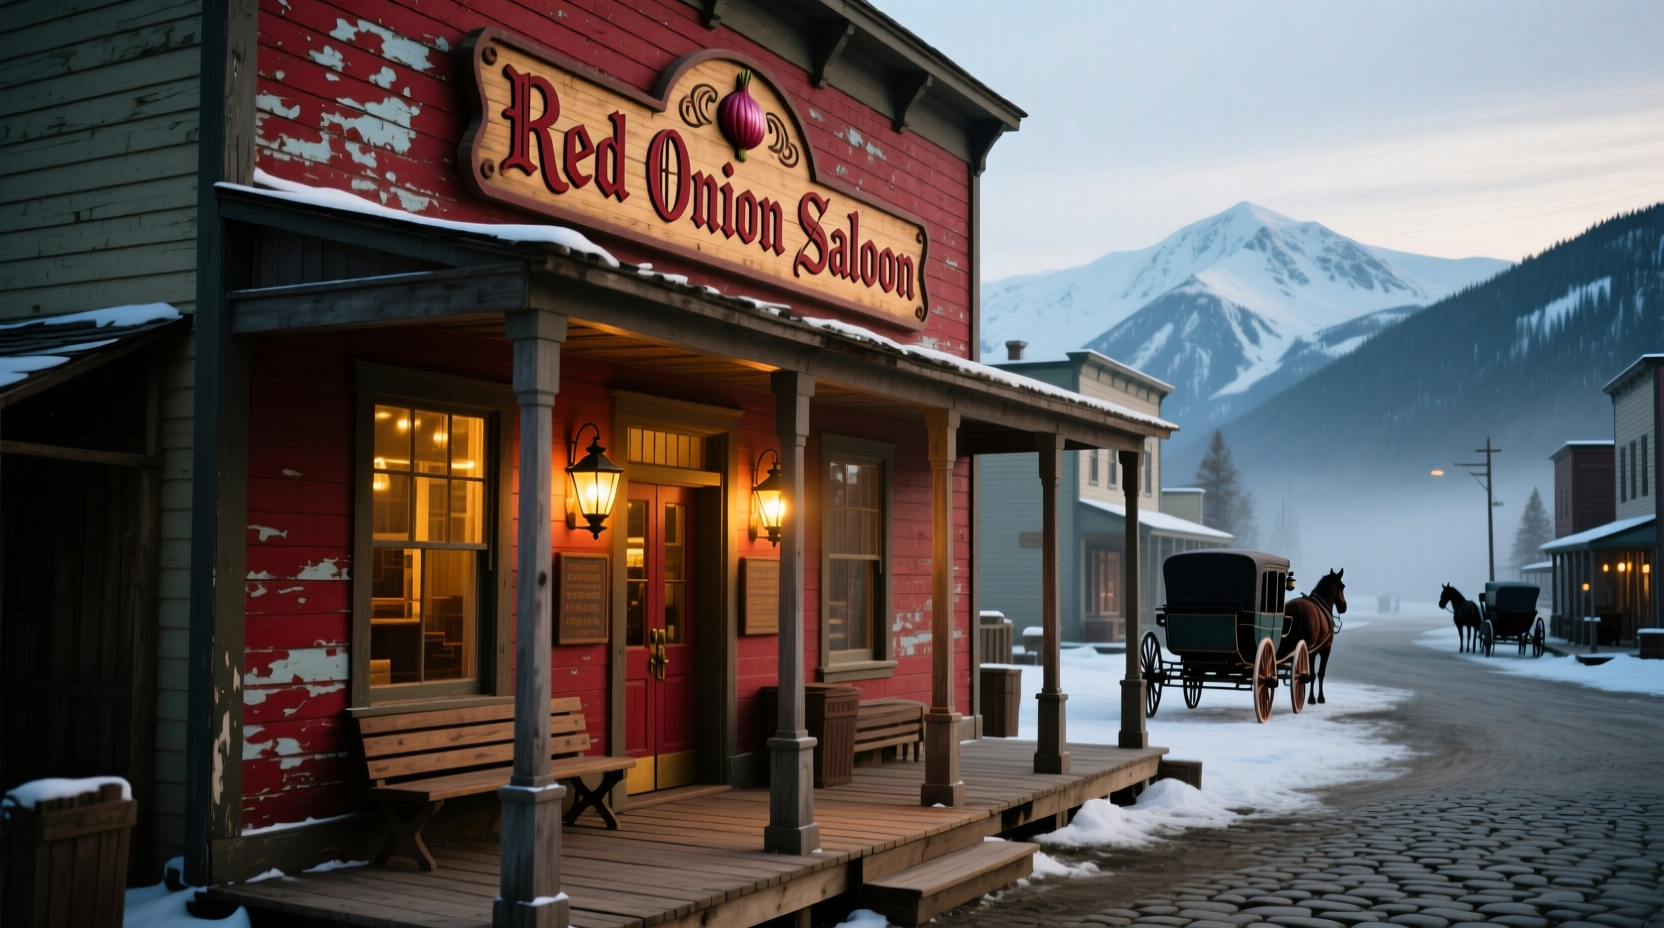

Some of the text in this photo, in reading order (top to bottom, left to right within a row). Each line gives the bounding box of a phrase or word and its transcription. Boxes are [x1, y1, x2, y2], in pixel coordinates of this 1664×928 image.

[500, 64, 915, 301] Red Onion Saloon
